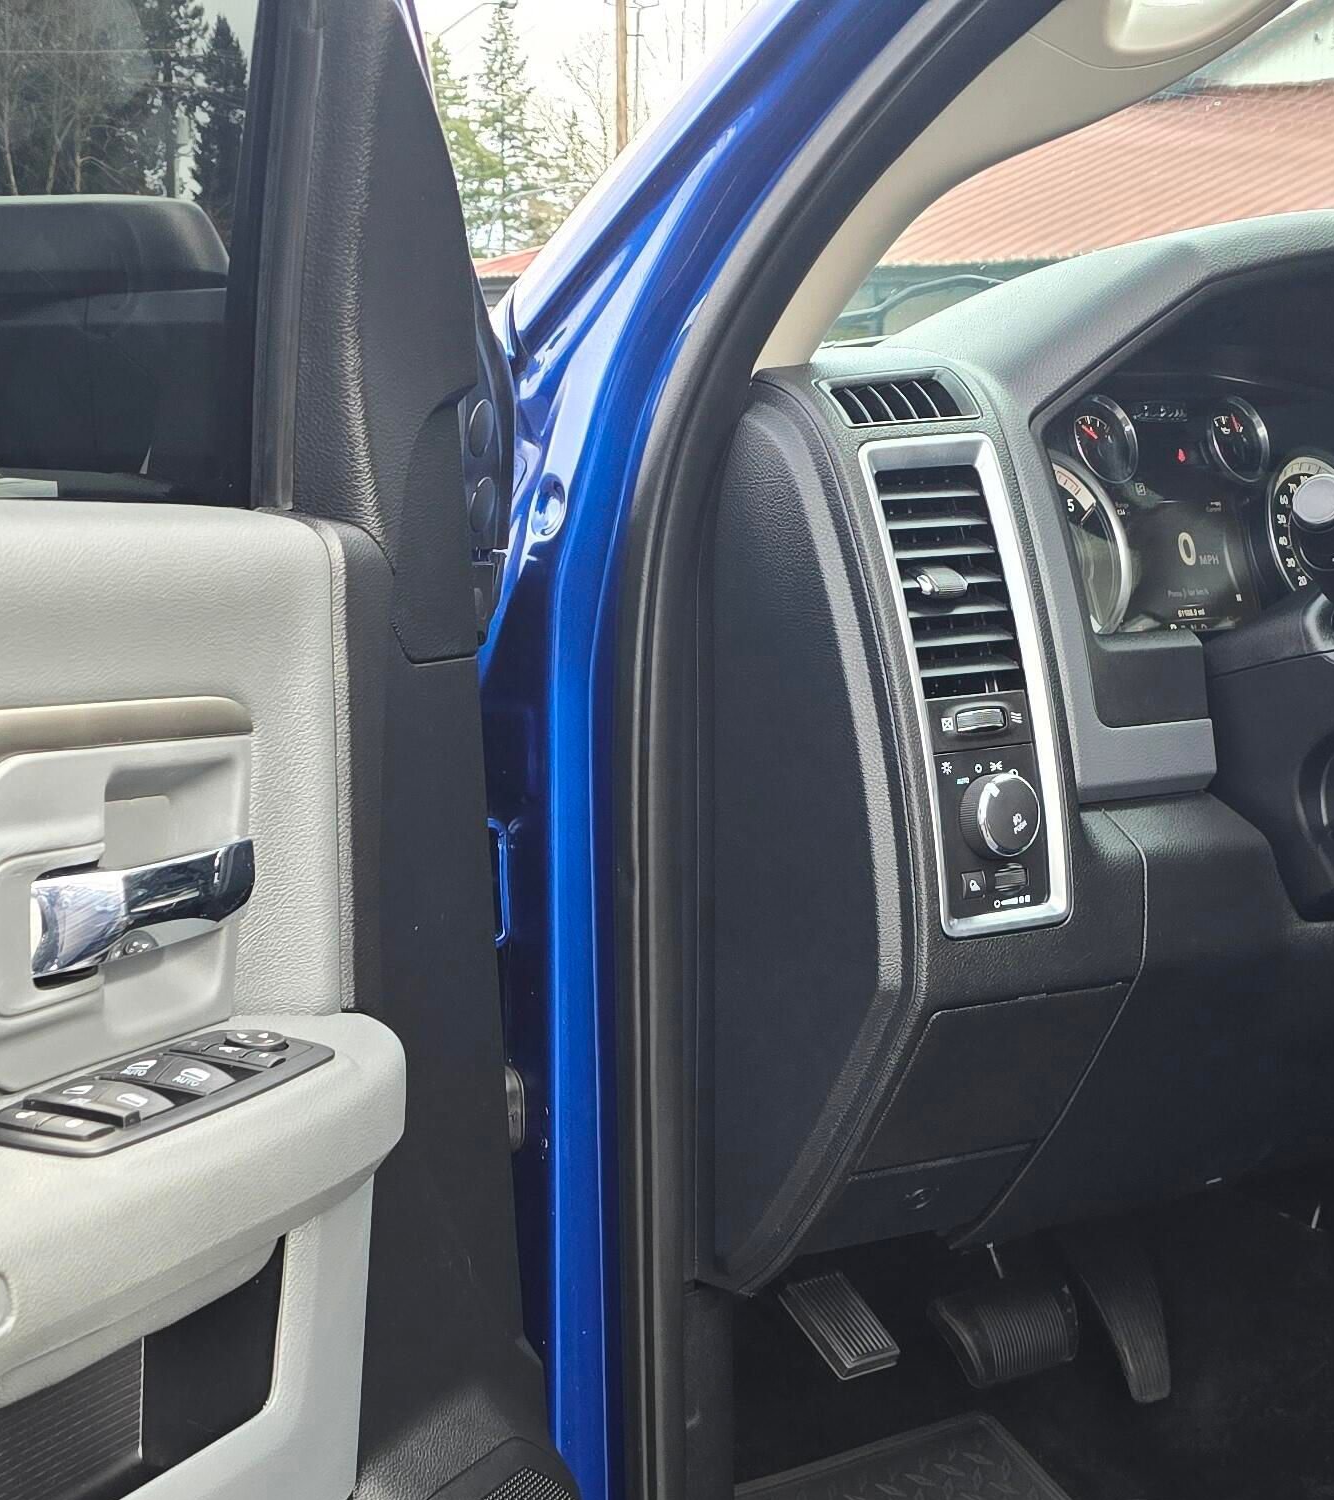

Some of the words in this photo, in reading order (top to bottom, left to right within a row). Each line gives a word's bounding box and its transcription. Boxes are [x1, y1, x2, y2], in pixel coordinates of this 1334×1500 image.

[1066, 498, 1075, 512] 5
[1279, 494, 1289, 505] 60
[1276, 513, 1287, 525] 50
[1278, 536, 1289, 546] 40
[1178, 531, 1196, 566] 0
[1198, 553, 1220, 566] MPH
[1285, 557, 1296, 568] 30
[1297, 575, 1308, 587] 20
[120, 1069, 147, 1077] AUTO
[172, 1075, 200, 1087] AUTO
